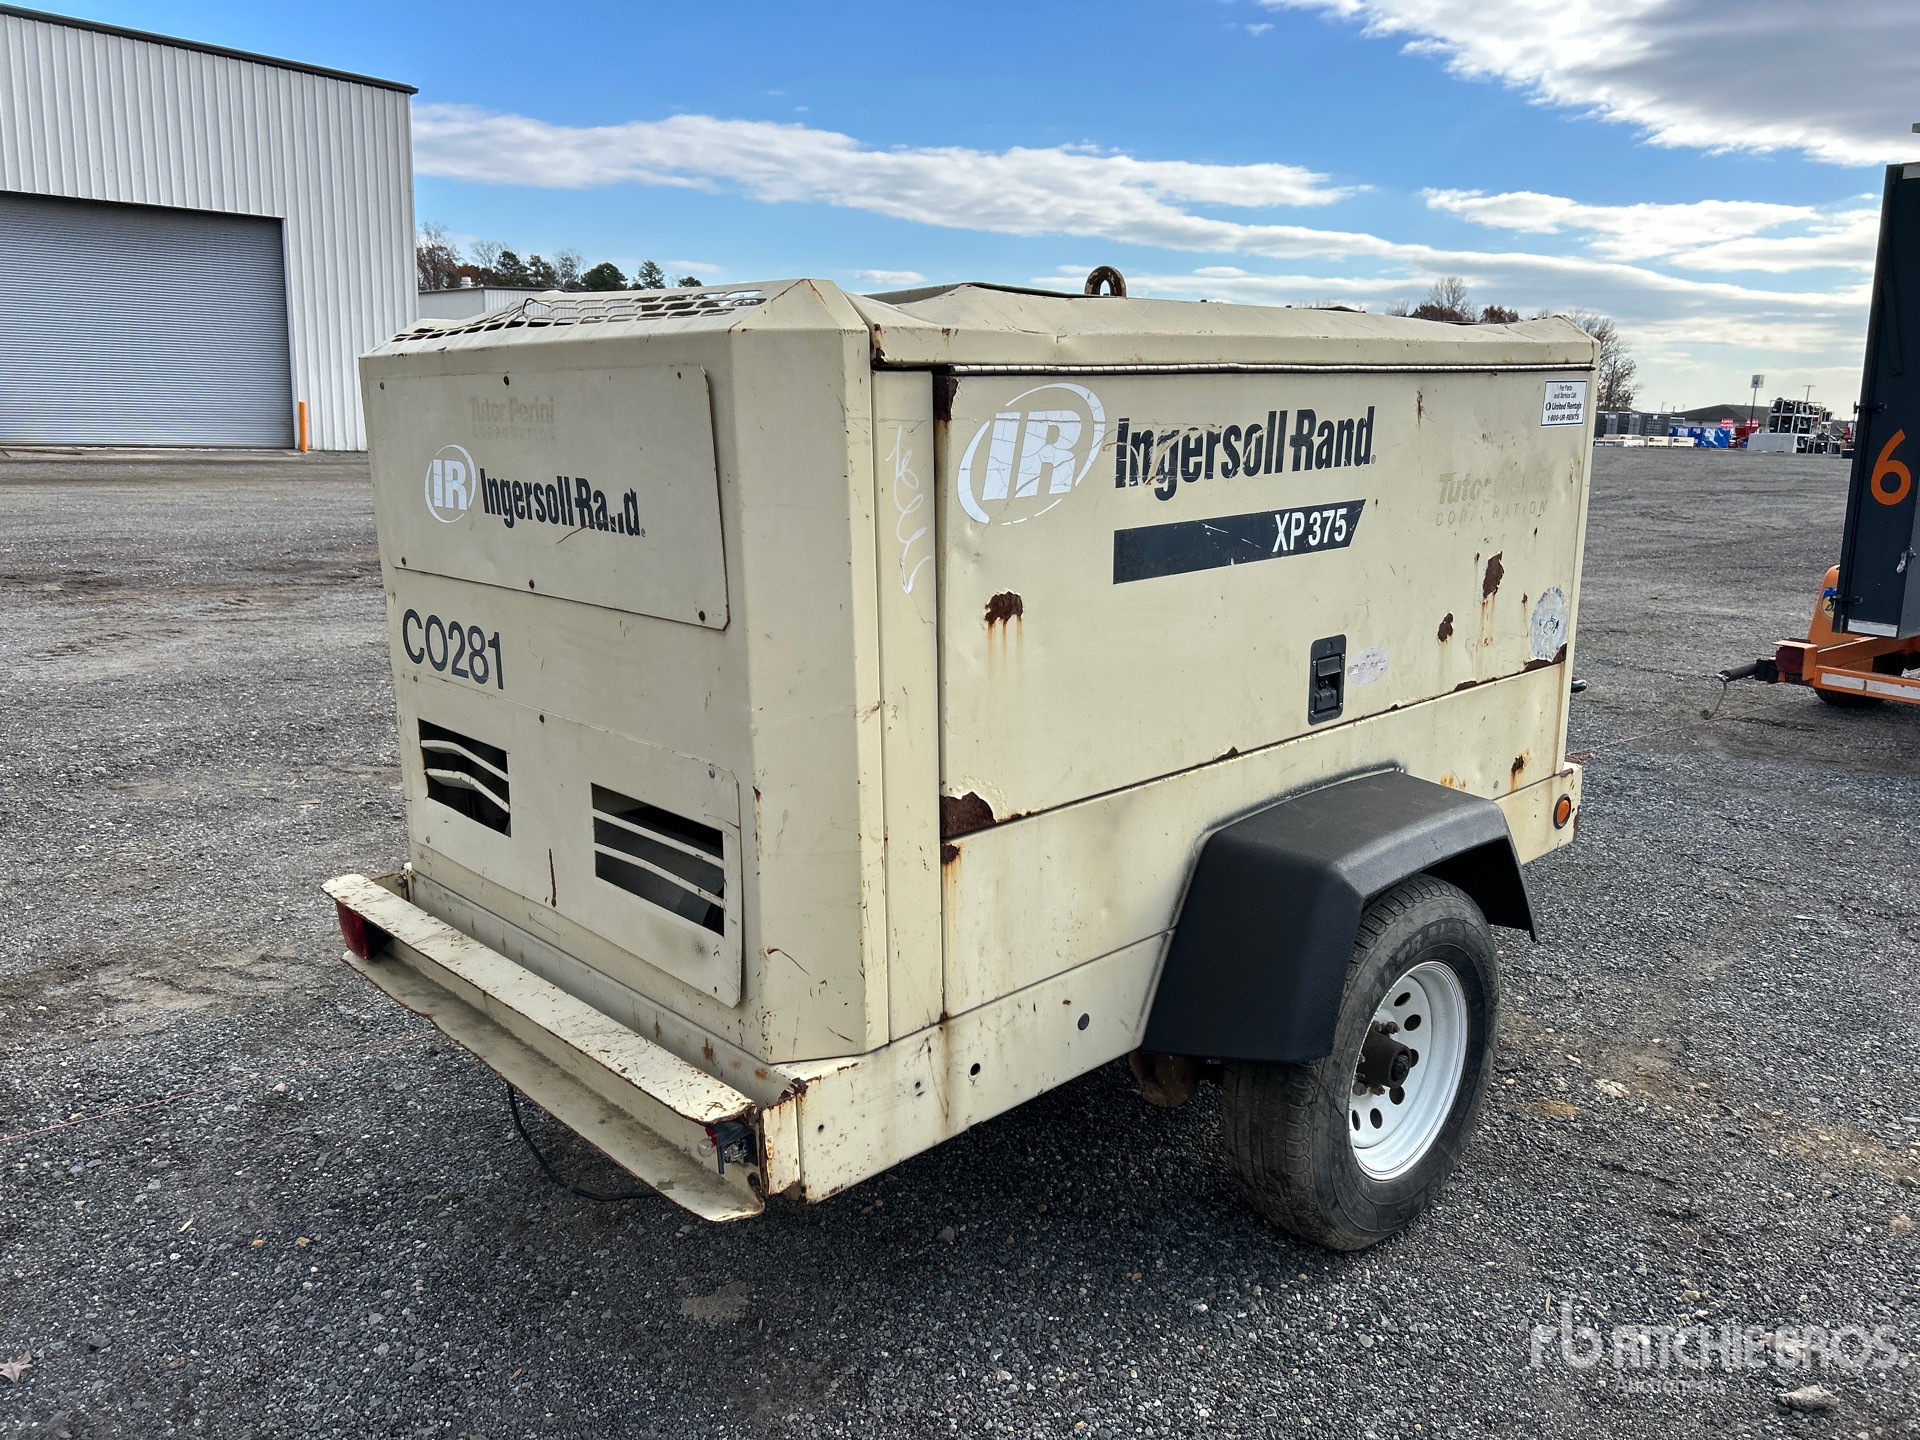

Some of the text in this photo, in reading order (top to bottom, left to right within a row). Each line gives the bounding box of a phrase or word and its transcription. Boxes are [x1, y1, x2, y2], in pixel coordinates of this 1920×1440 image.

[432, 459, 468, 511] IR
[983, 411, 1081, 500] IR
[1871, 429, 1911, 505] 6
[479, 467, 574, 528] Ingersoll
[1272, 507, 1348, 552] XP 375
